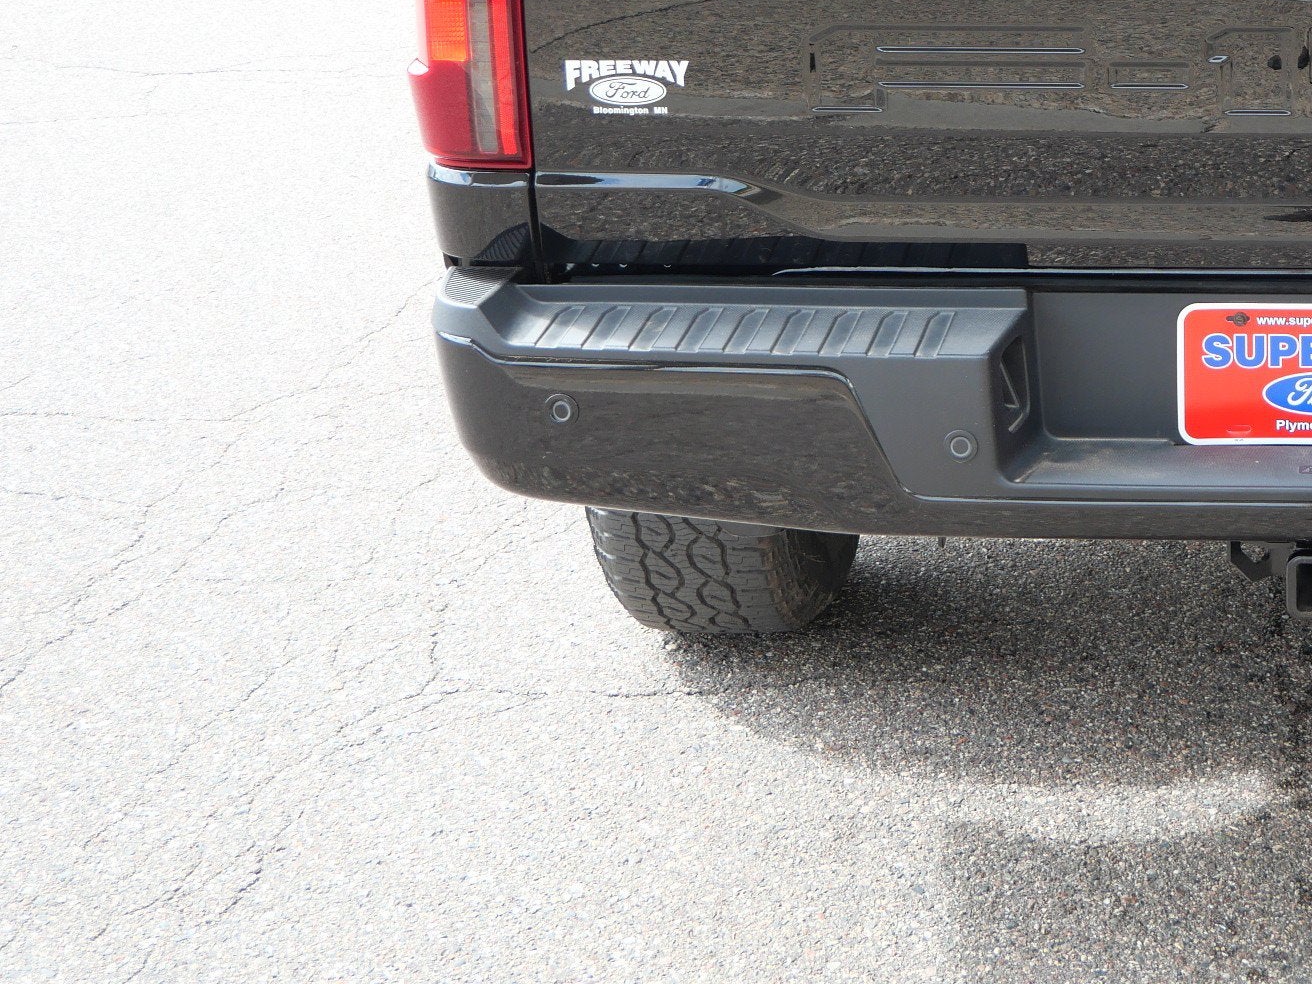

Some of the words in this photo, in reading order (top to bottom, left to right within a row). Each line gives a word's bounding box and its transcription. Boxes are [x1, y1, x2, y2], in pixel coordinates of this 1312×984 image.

[564, 59, 690, 91] FREEWAY
[605, 81, 651, 99] Ford
[592, 106, 649, 116] Bloomington
[653, 106, 668, 114] MN
